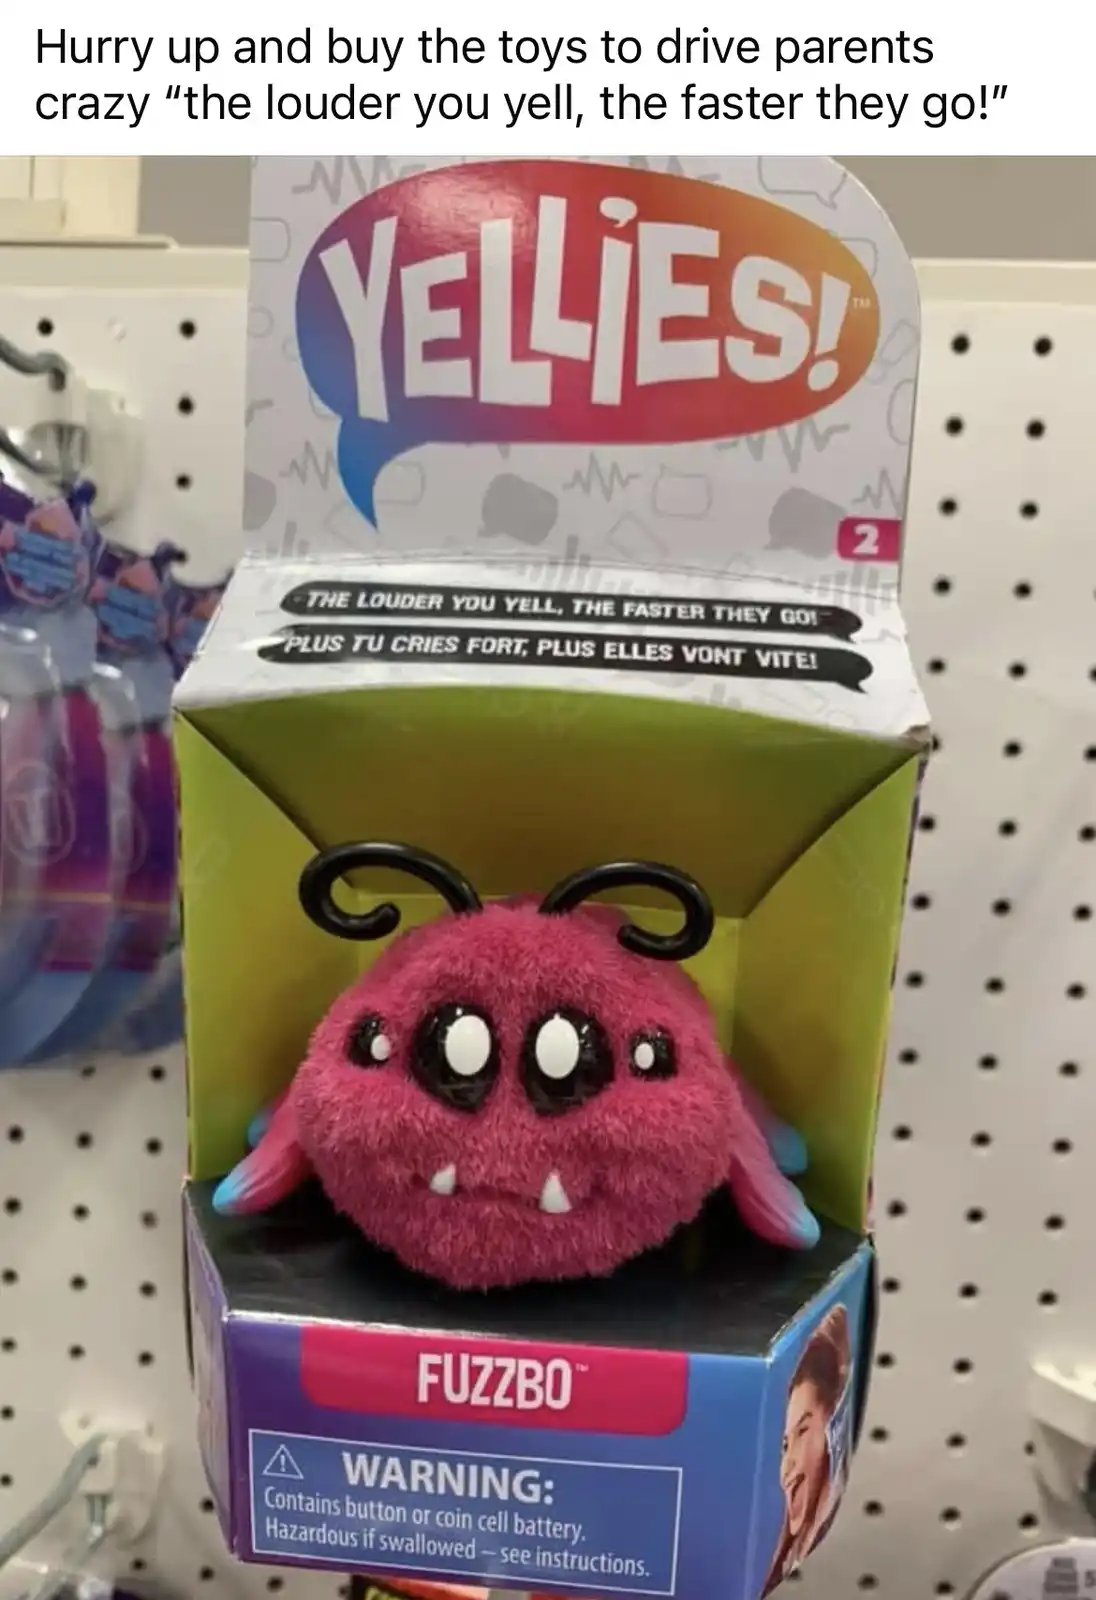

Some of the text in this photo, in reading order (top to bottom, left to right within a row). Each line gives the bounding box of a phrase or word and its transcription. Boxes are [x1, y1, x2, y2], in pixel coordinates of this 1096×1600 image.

[852, 524, 879, 555] 2
[306, 590, 818, 626] THE LOUDER YOU YELL, THE FASTER THEY GO!
[283, 634, 819, 670] PLUS TU CRIES FORT, PLUS ELLES VONT VITE!
[417, 1352, 573, 1410] FUZZBO
[342, 1451, 554, 1505] WARNING:
[264, 1486, 586, 1546] Contains button or coin cell battery.
[266, 1516, 358, 1548] Hazardous
[363, 1528, 376, 1549] if
[379, 1533, 476, 1560] swallowed
[500, 1546, 532, 1566] see
[536, 1548, 650, 1577] instructions.
